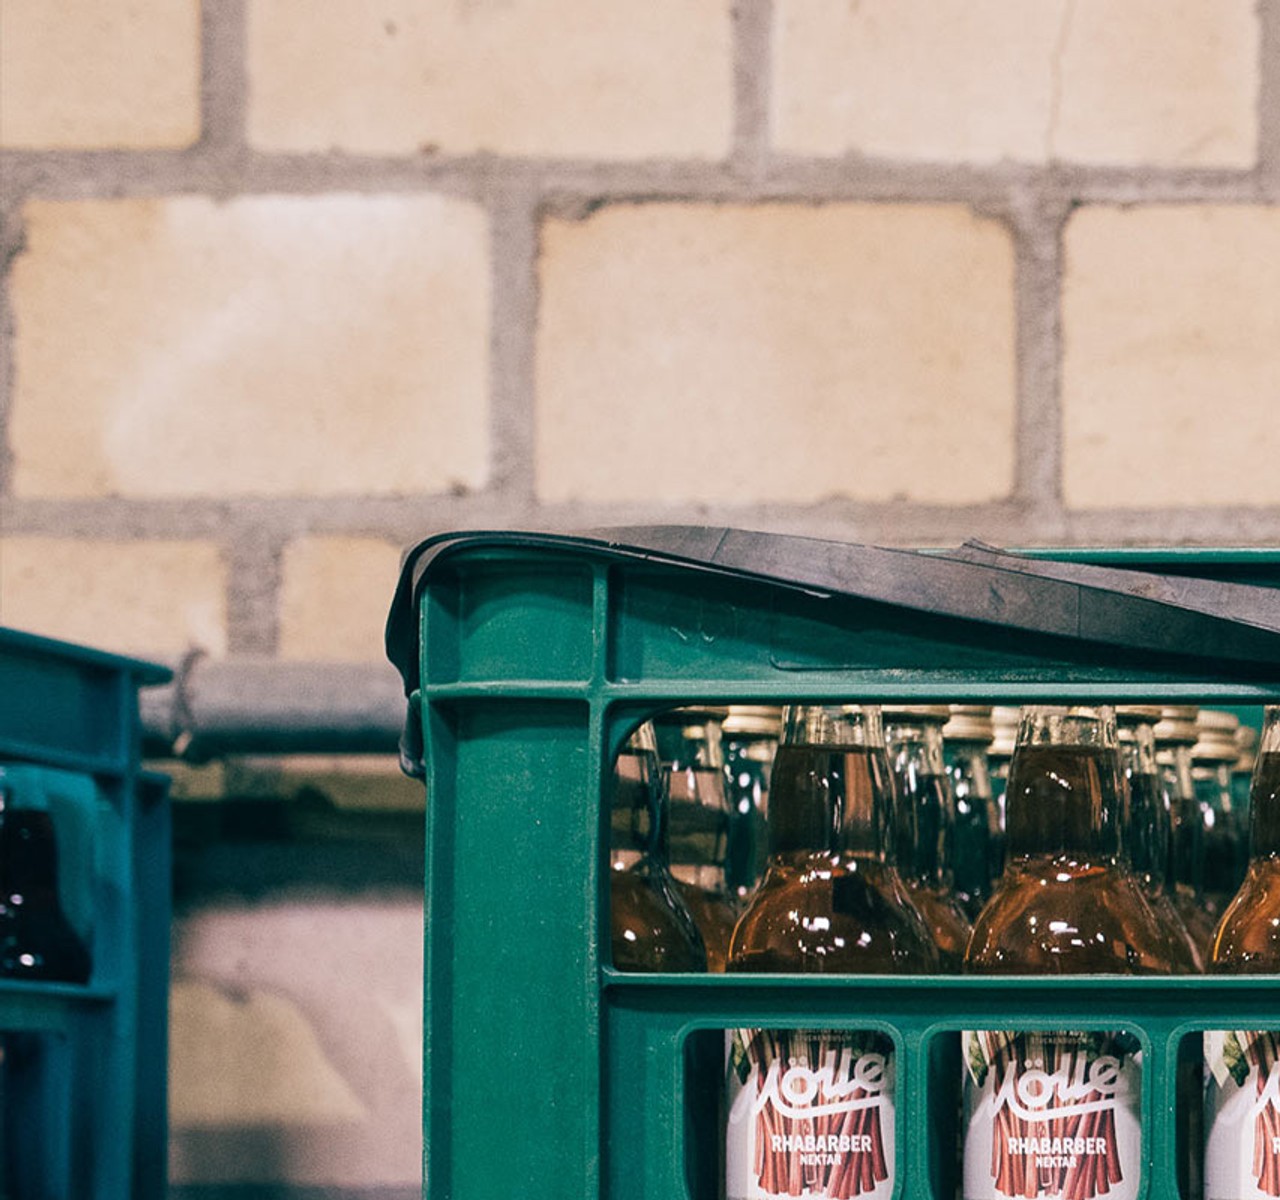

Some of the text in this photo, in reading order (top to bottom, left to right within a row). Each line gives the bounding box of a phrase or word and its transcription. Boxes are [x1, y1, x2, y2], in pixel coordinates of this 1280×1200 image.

[771, 1135, 872, 1152] RHABARBER
[1008, 1137, 1107, 1155] RHABARBER
[800, 1154, 841, 1165] NEKTAR
[1035, 1156, 1076, 1168] NEKTAR
